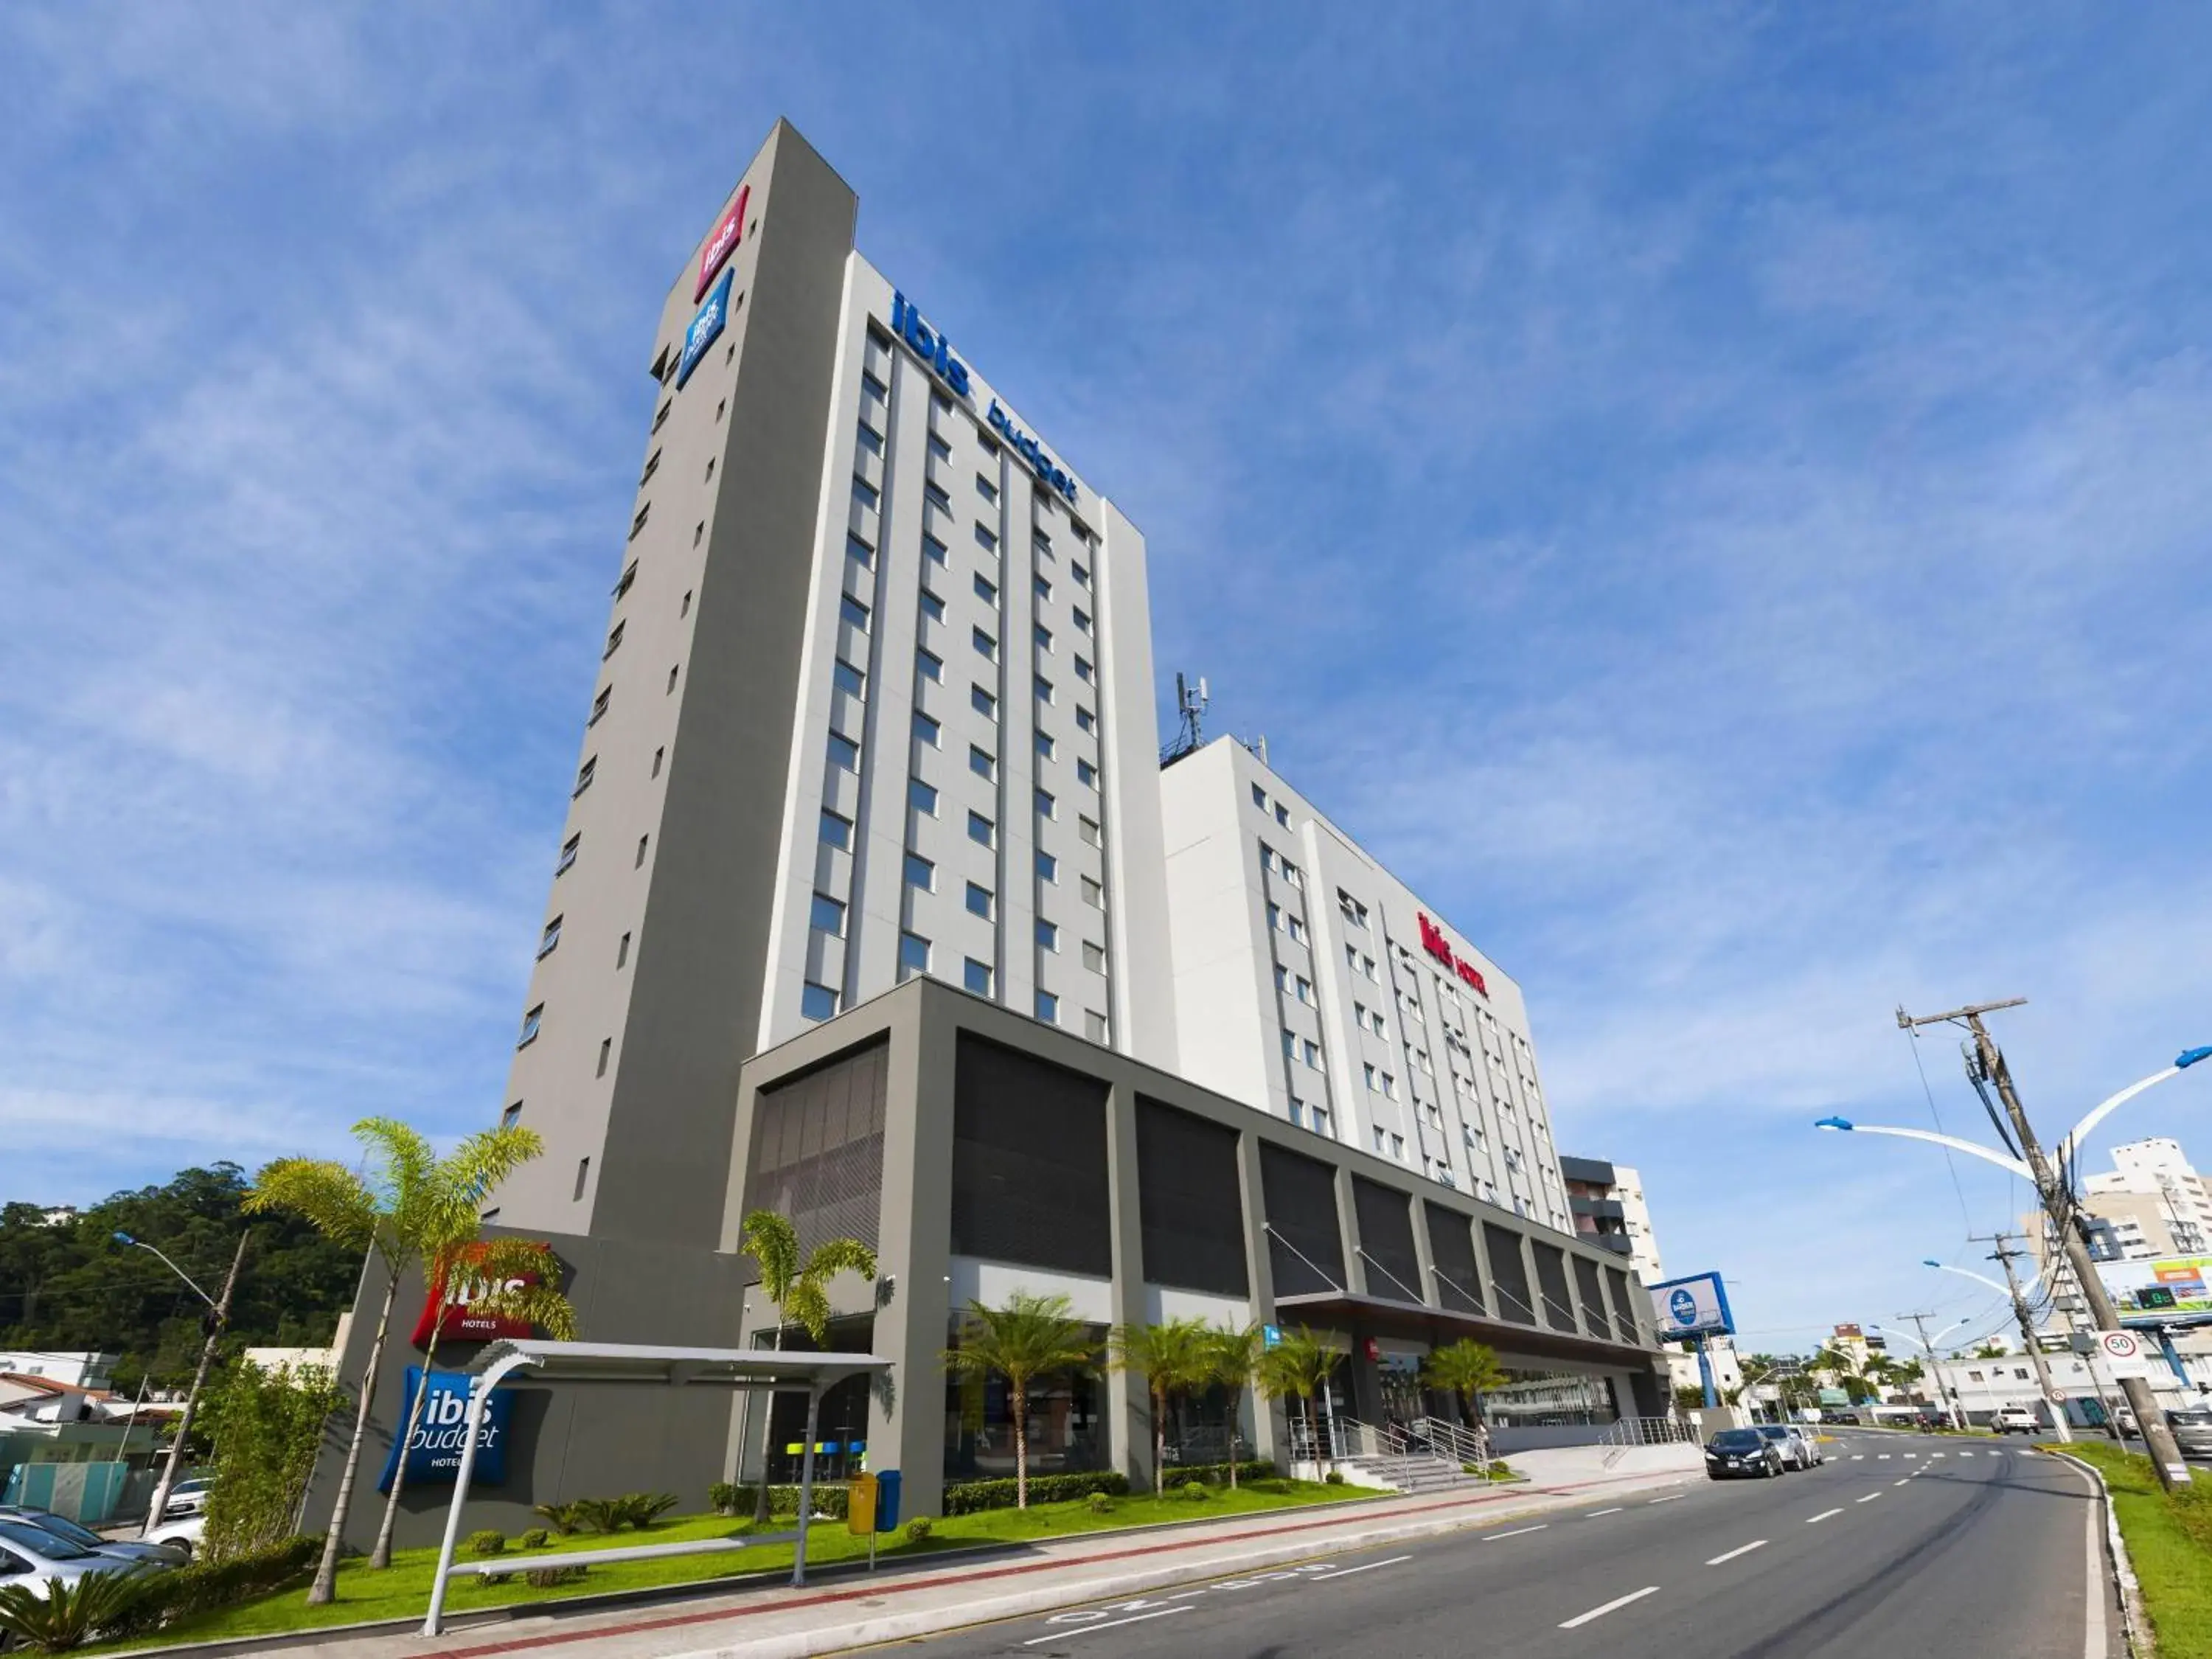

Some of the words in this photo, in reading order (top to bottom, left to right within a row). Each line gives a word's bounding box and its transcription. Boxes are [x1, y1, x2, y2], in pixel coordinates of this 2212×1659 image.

[891, 290, 969, 397] ibis
[987, 398, 1077, 503] budget
[462, 1319, 496, 1329] HOTELS
[2111, 1338, 2129, 1349] 50
[426, 1390, 493, 1425] ibis
